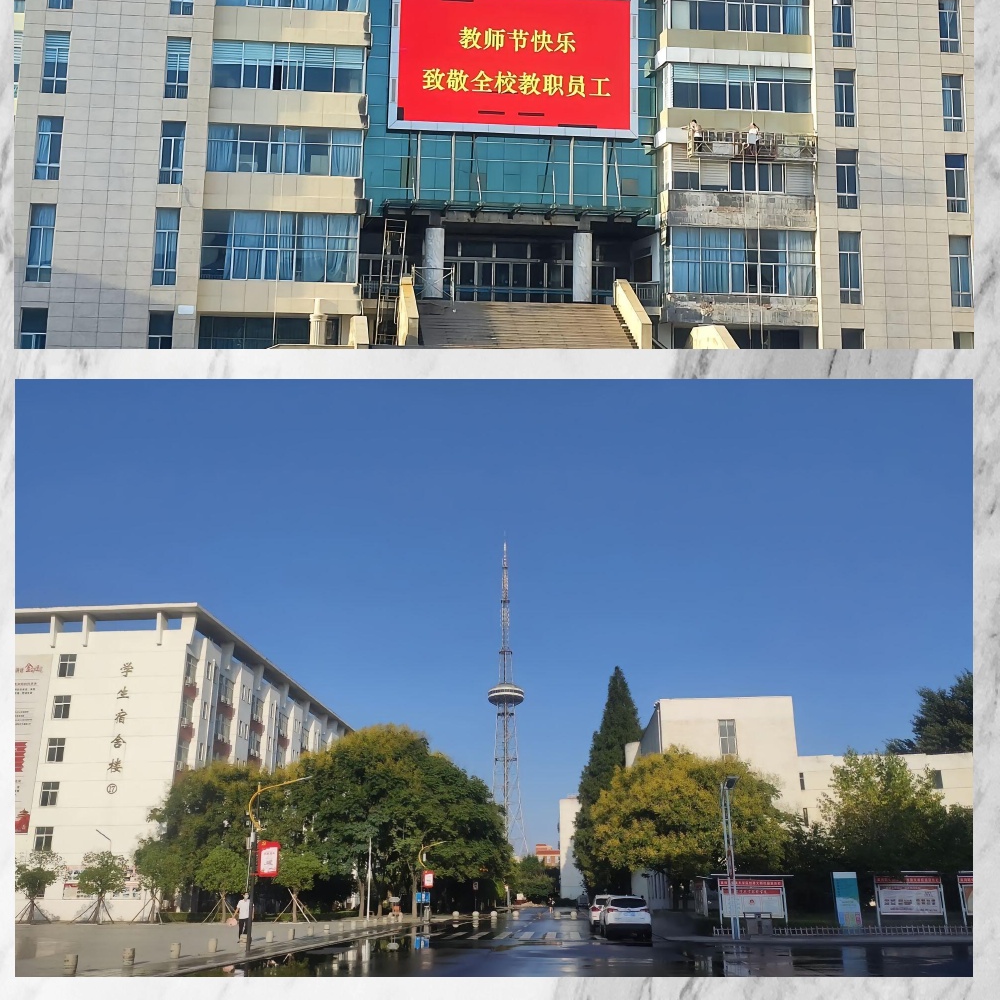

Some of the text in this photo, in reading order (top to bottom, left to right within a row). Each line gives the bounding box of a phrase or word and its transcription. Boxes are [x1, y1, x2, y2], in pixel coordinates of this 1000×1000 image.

[458, 26, 577, 54] 教师节快乐
[422, 68, 612, 98] 致敬全校教职员工
[107, 662, 134, 774] 学生宿舍楼
